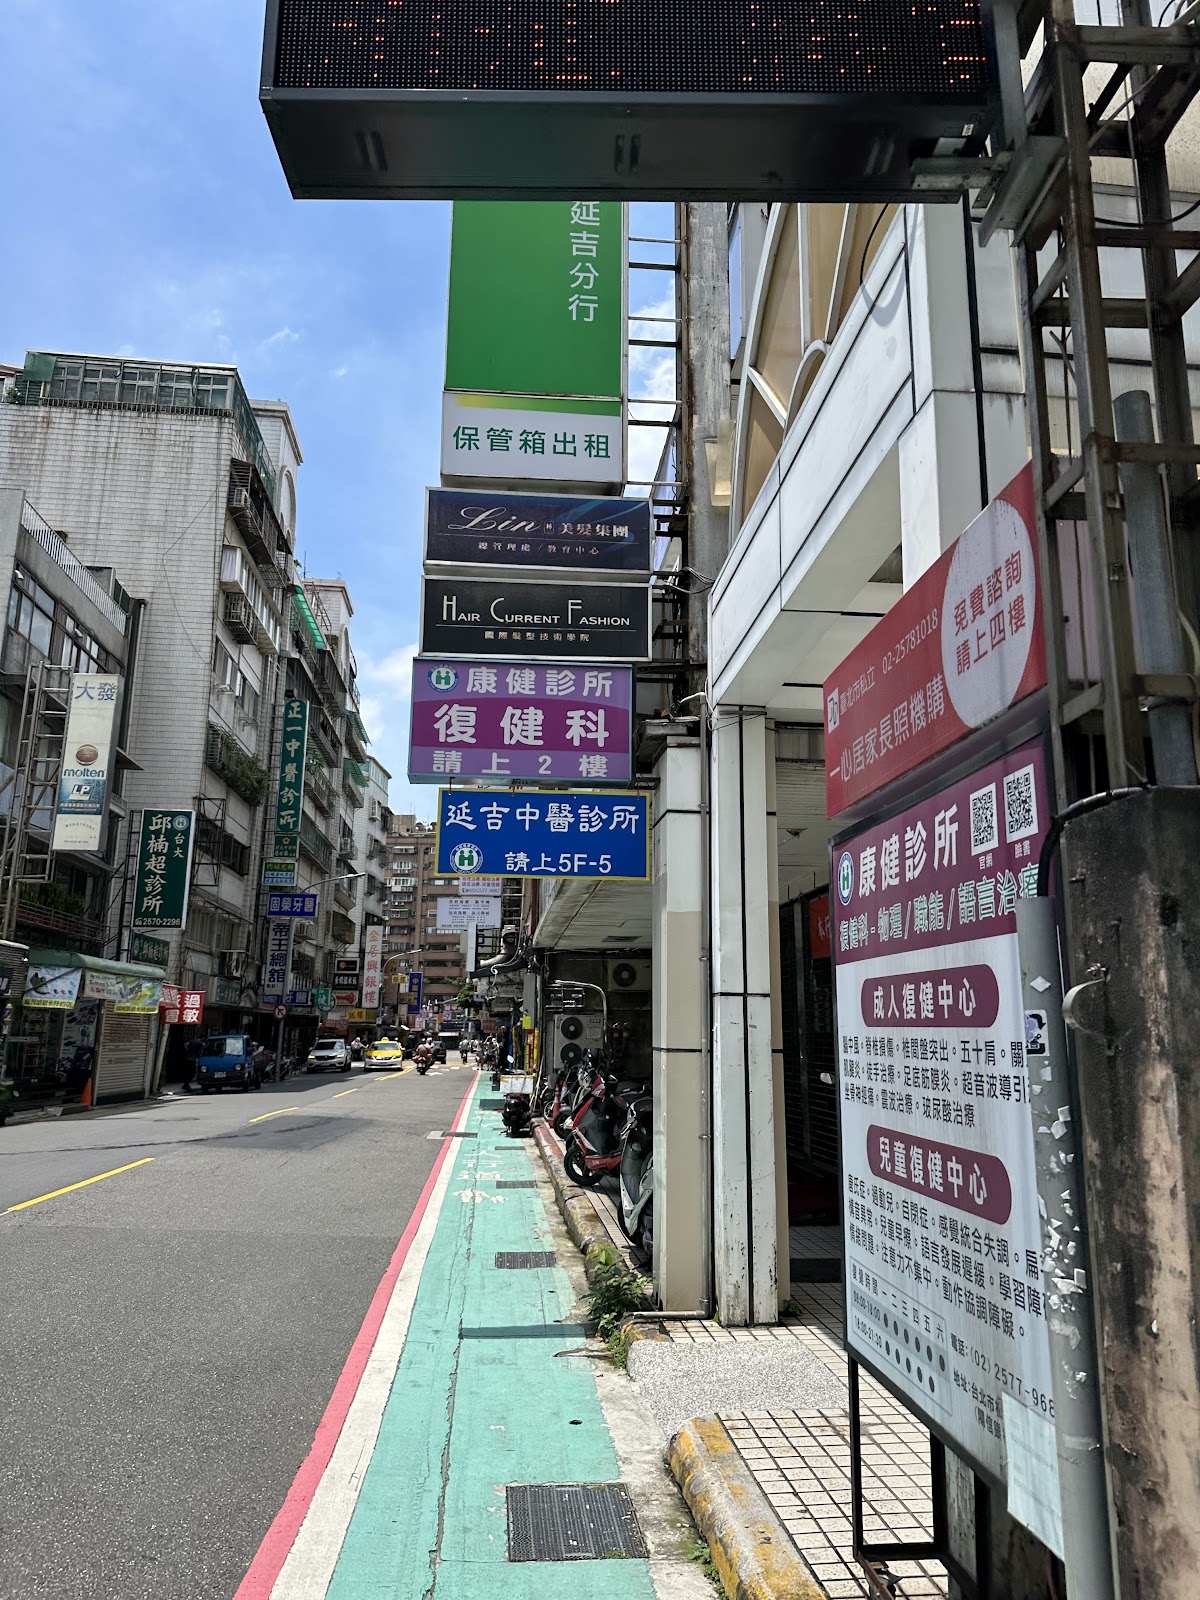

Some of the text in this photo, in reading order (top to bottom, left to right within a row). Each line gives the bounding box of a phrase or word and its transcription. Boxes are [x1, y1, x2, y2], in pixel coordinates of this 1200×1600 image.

[568, 201, 600, 322] 延吉分行
[453, 425, 610, 458] 保管箱出租
[448, 507, 540, 532] Lin
[560, 522, 629, 538] 美髮集團
[547, 544, 600, 555] 教育中心
[954, 550, 1022, 636] 免費諮詢
[443, 596, 630, 626] HAIR CURRENT FASHION
[882, 608, 938, 675] 02-25781018
[956, 595, 1026, 676] 請上四樓
[75, 681, 117, 701] 大發
[466, 666, 613, 697] 康健診所
[433, 704, 610, 747] 復健科
[64, 768, 105, 778] molten
[280, 702, 302, 829] 正一中醫診所
[432, 750, 608, 778] 請上2樓
[72, 785, 91, 795] LP
[445, 800, 640, 835] 延吉中醫診所
[173, 832, 185, 858] 台大
[858, 804, 959, 898] 康健診所
[141, 813, 172, 916] 邱楠超診所
[504, 851, 612, 874] 請上5F-5
[143, 917, 180, 926] 2570-2296
[269, 923, 290, 983] 帝王總館
[183, 994, 200, 1023] 過敏
[873, 977, 976, 1019] 成人復健中心
[879, 1136, 987, 1205] 兒童復健中心
[902, 1300, 908, 1317] 三
[913, 1307, 919, 1325] 四
[924, 1314, 931, 1333] 五
[936, 1324, 944, 1342] 六
